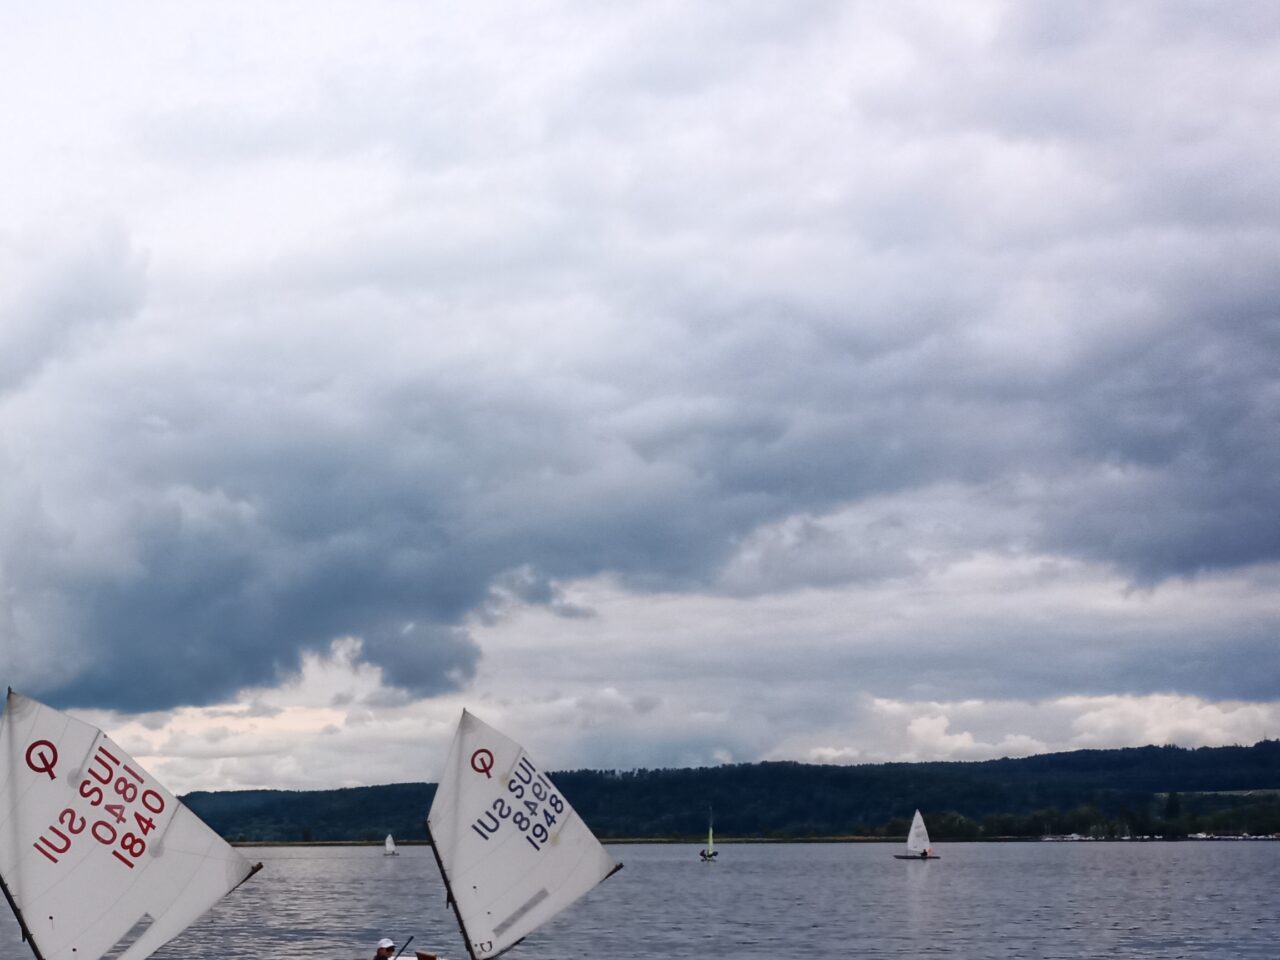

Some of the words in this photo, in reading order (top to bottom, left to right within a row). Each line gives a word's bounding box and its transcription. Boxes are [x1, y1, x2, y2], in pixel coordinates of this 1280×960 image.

[79, 746, 121, 806] SUI
[508, 757, 536, 799] SUI
[112, 789, 165, 869] 1840
[526, 794, 563, 851] 1948
